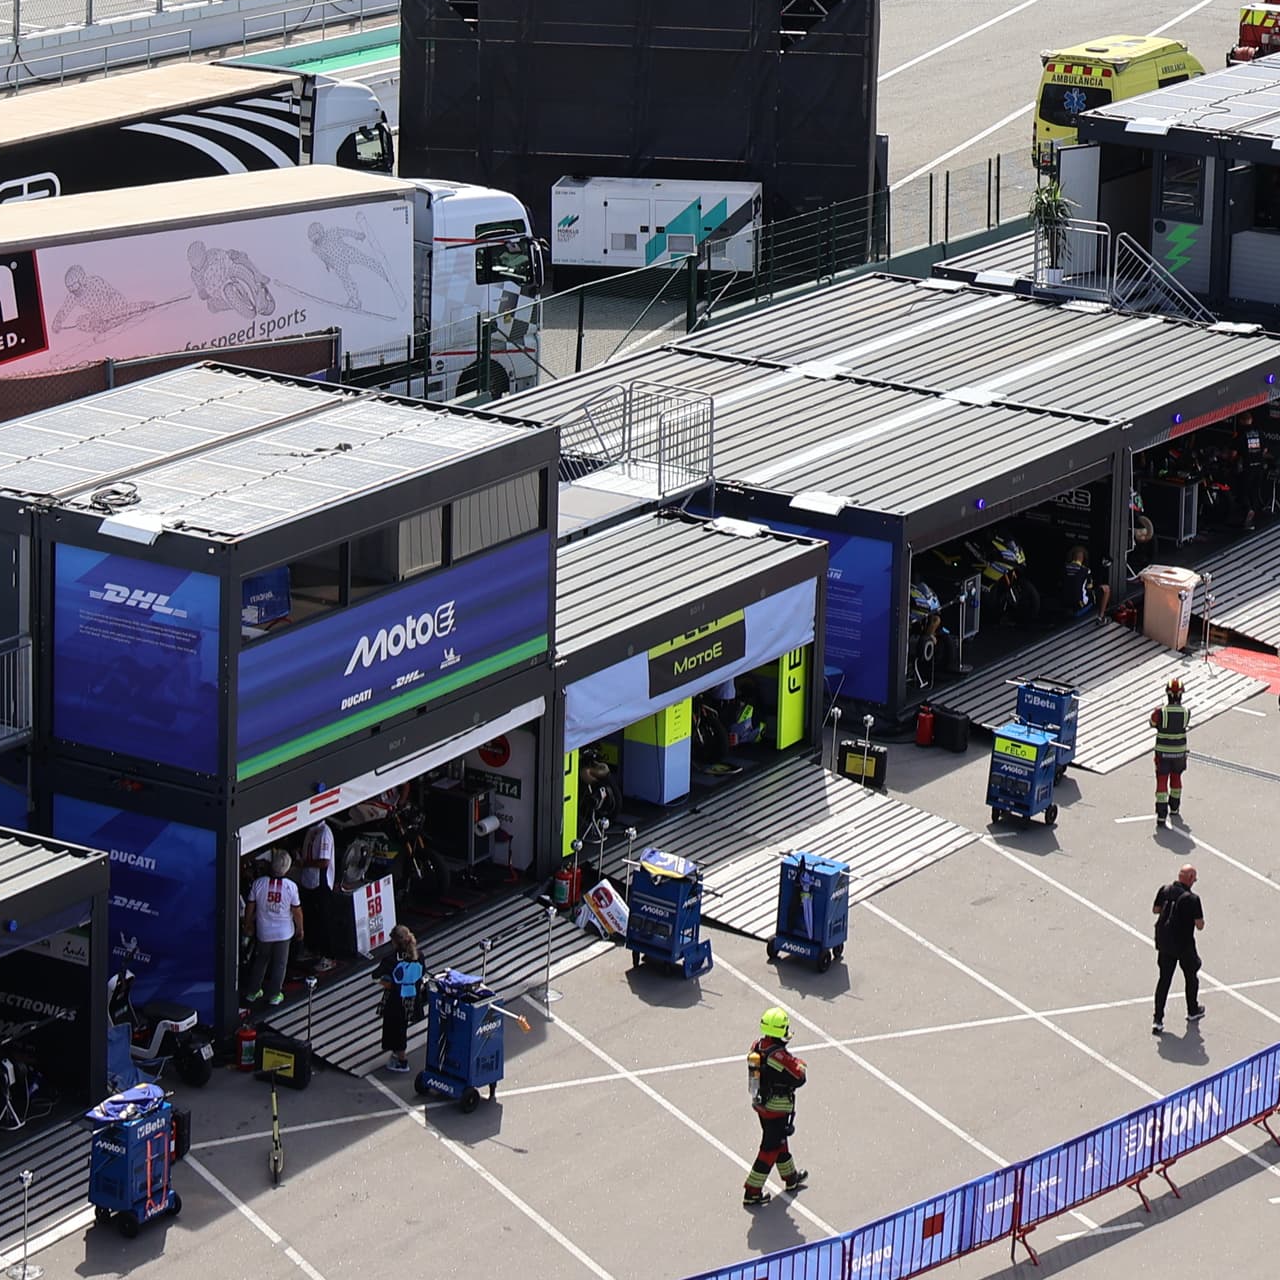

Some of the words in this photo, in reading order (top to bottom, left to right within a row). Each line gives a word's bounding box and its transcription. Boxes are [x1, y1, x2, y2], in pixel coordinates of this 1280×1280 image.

[211, 317, 254, 350] speed
[258, 307, 307, 341] sports
[102, 583, 176, 613] DHL
[344, 600, 455, 677] MotoE
[339, 688, 373, 711] DUCATI
[1032, 697, 1056, 710] Beta
[1005, 745, 1027, 758] FELO
[110, 849, 156, 871] DUCATI
[114, 896, 150, 914] DHL
[267, 891, 282, 904] 58
[368, 896, 383, 918] 58
[144, 1118, 166, 1137] Beta
